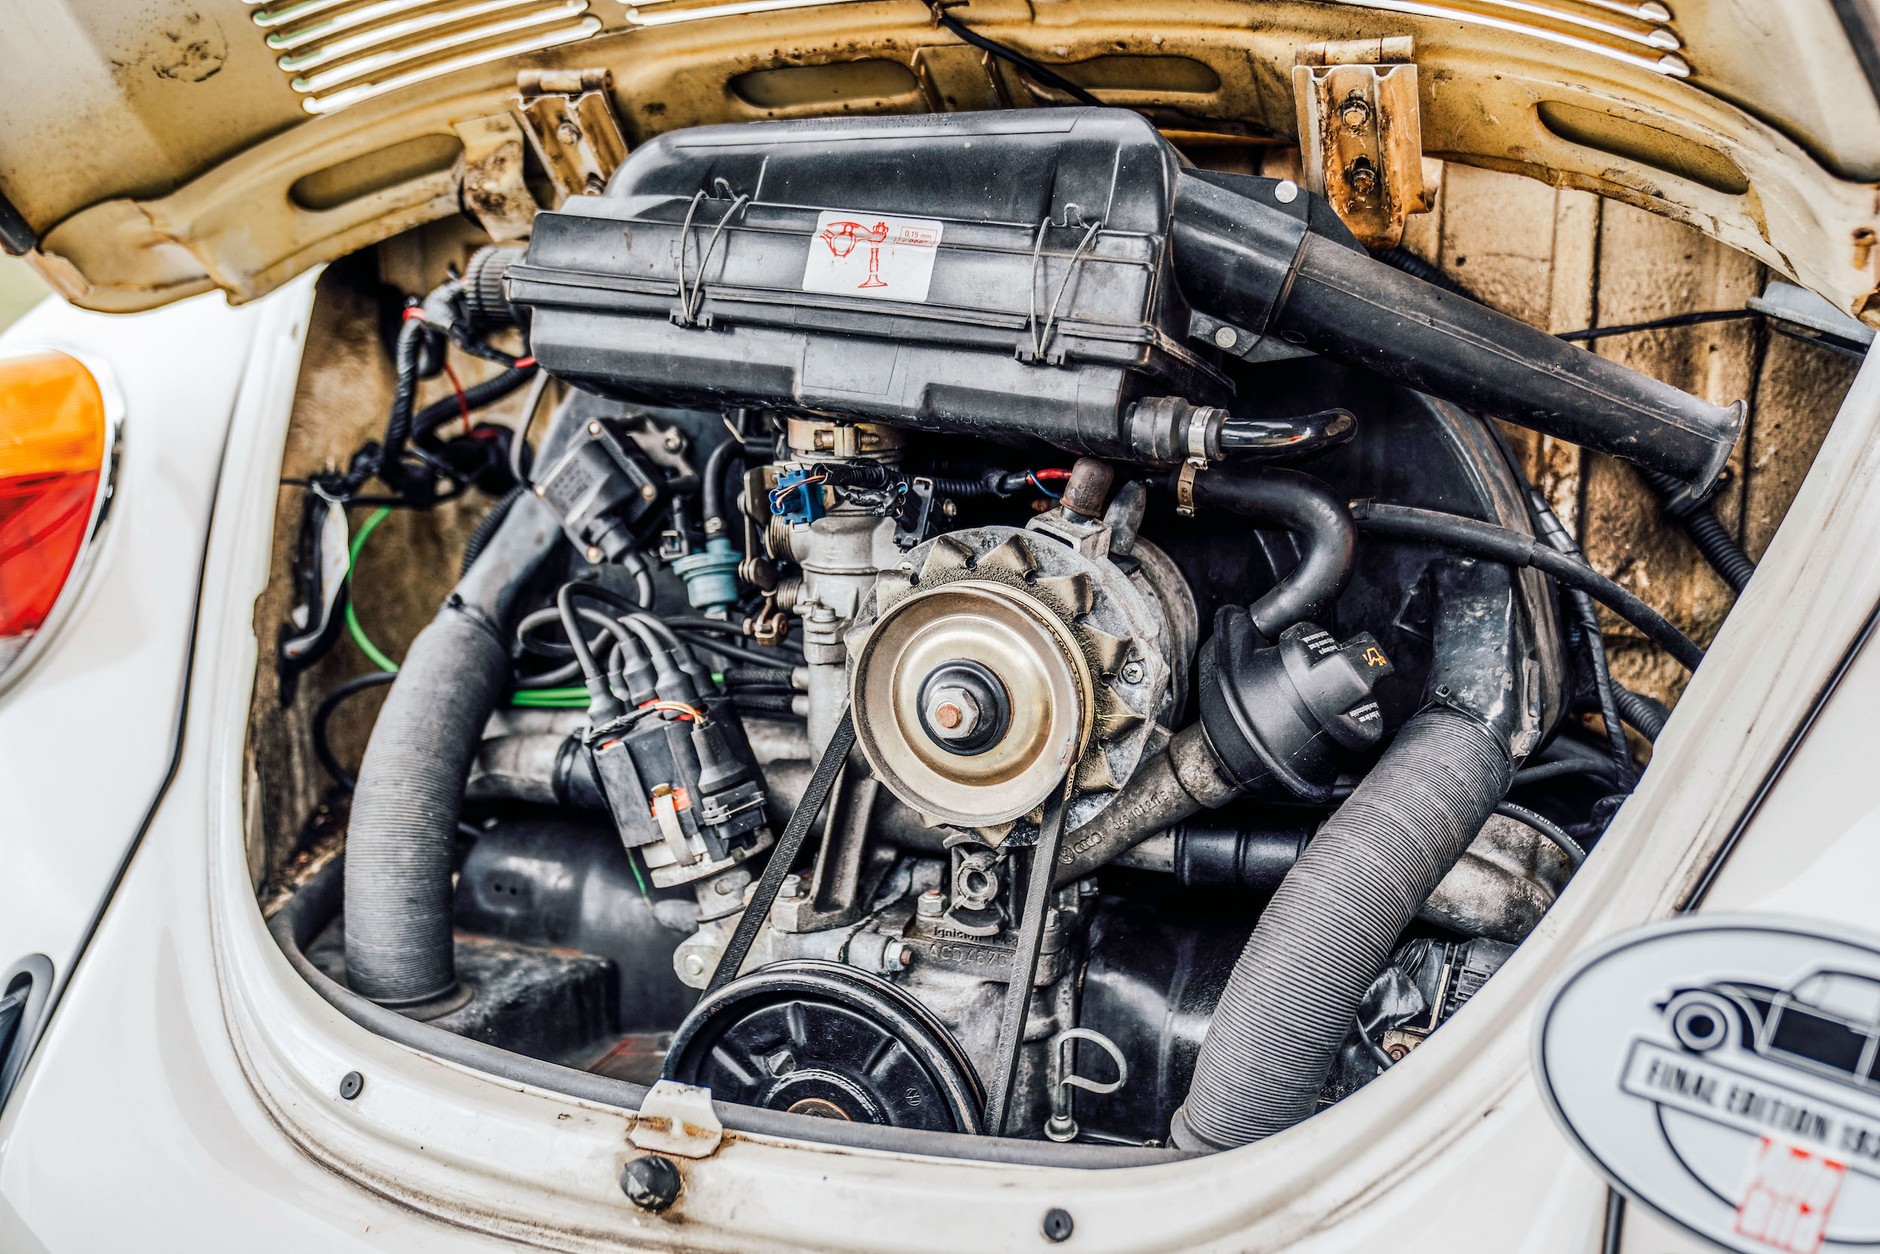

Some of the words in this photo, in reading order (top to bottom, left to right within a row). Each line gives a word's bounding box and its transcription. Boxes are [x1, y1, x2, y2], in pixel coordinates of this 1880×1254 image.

[1507, 802, 1528, 813] 7MM
[1533, 812, 1550, 825] USA
[1554, 825, 1563, 834] IN
[1646, 1058, 1718, 1106] FINAL
[1725, 1086, 1831, 1142] EDITION
